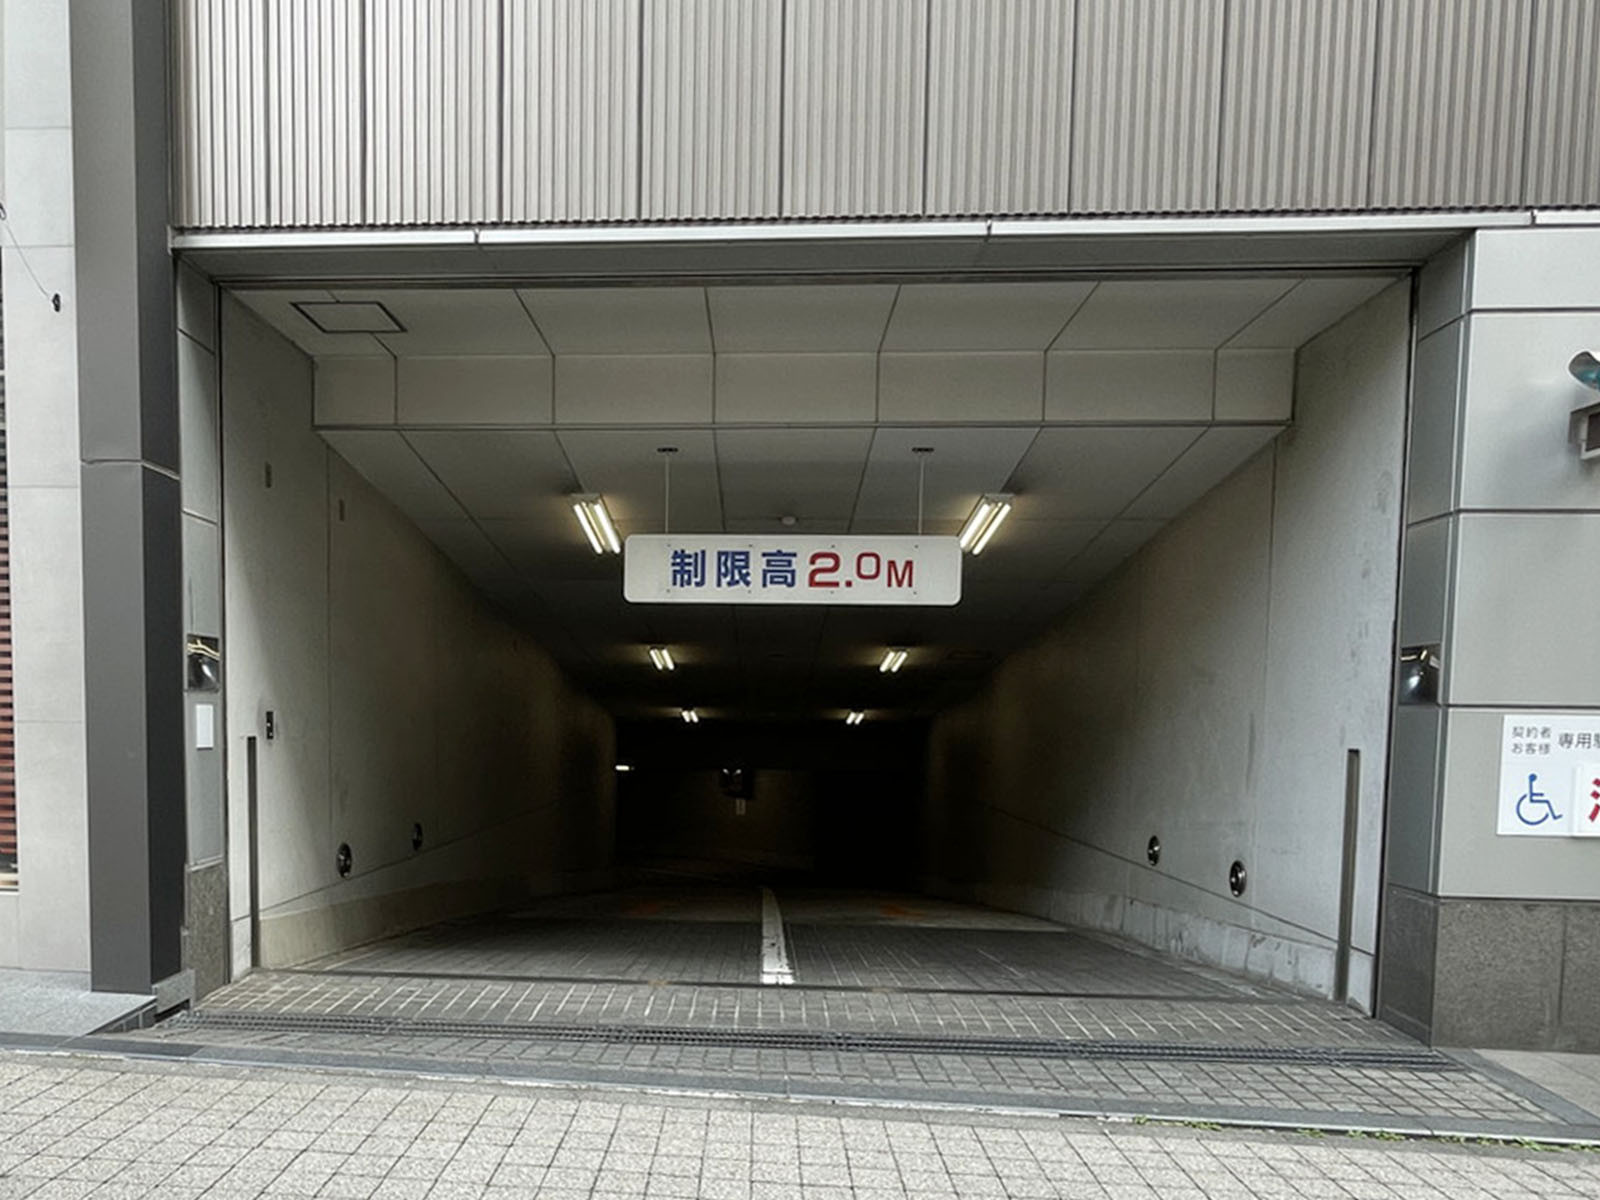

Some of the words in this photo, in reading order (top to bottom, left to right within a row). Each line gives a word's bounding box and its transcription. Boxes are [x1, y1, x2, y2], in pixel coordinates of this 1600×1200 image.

[671, 549, 914, 588] 制限高2.0M
[1512, 726, 1551, 739] 契約者
[1511, 743, 1551, 755] お客様
